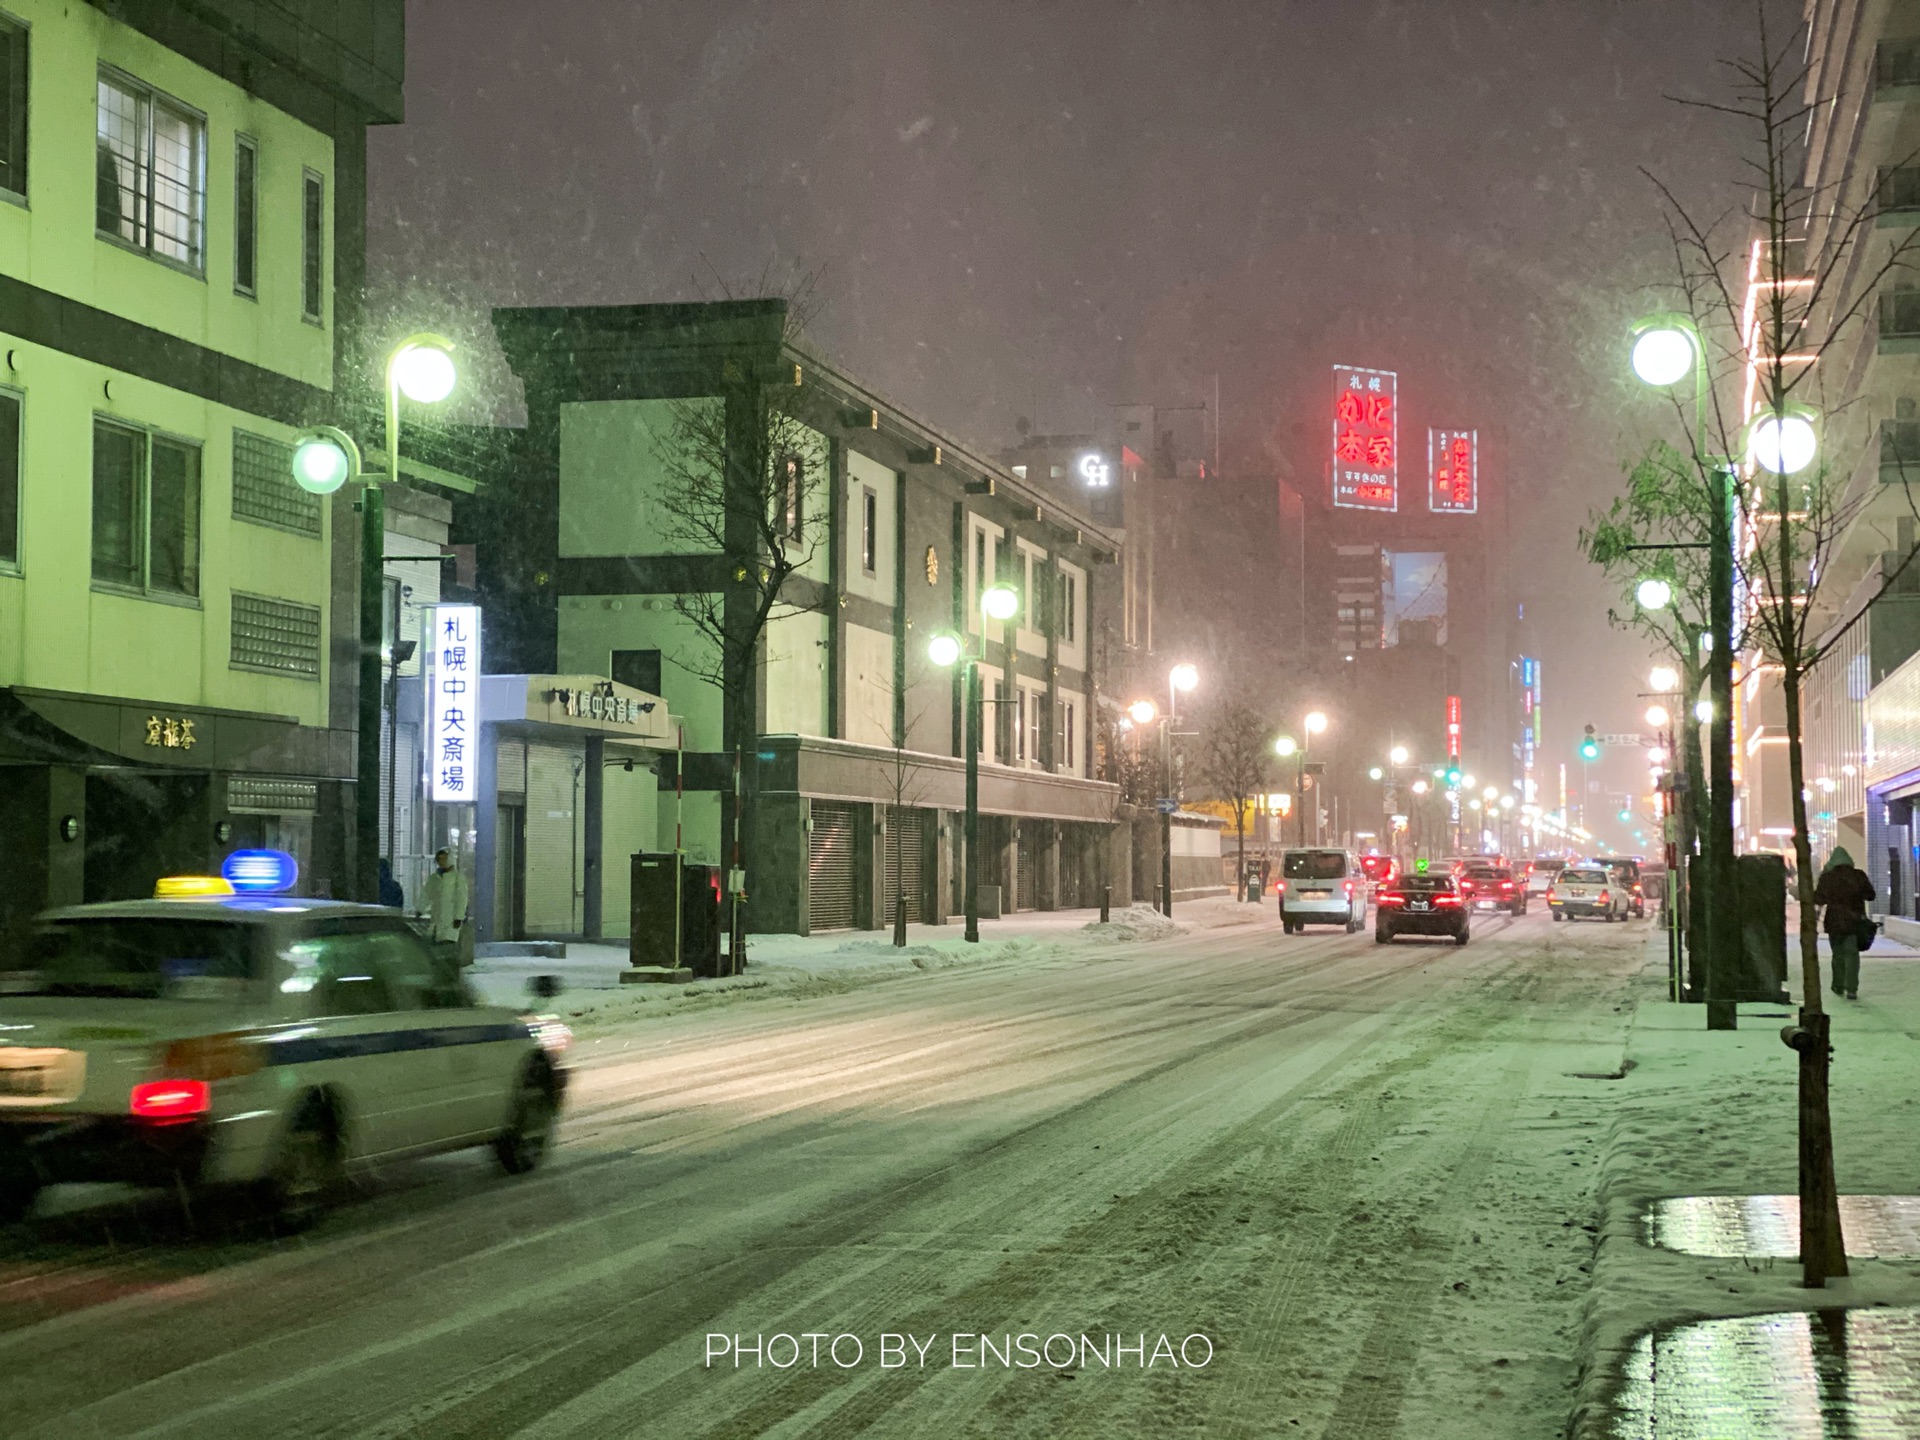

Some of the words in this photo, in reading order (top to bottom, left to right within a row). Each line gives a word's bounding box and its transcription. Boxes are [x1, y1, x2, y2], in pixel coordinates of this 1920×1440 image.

[1350, 375, 1381, 392] 札幌
[1337, 391, 1392, 430] かに
[1337, 429, 1393, 469] 本家
[440, 615, 468, 793] 札幌中央斎場
